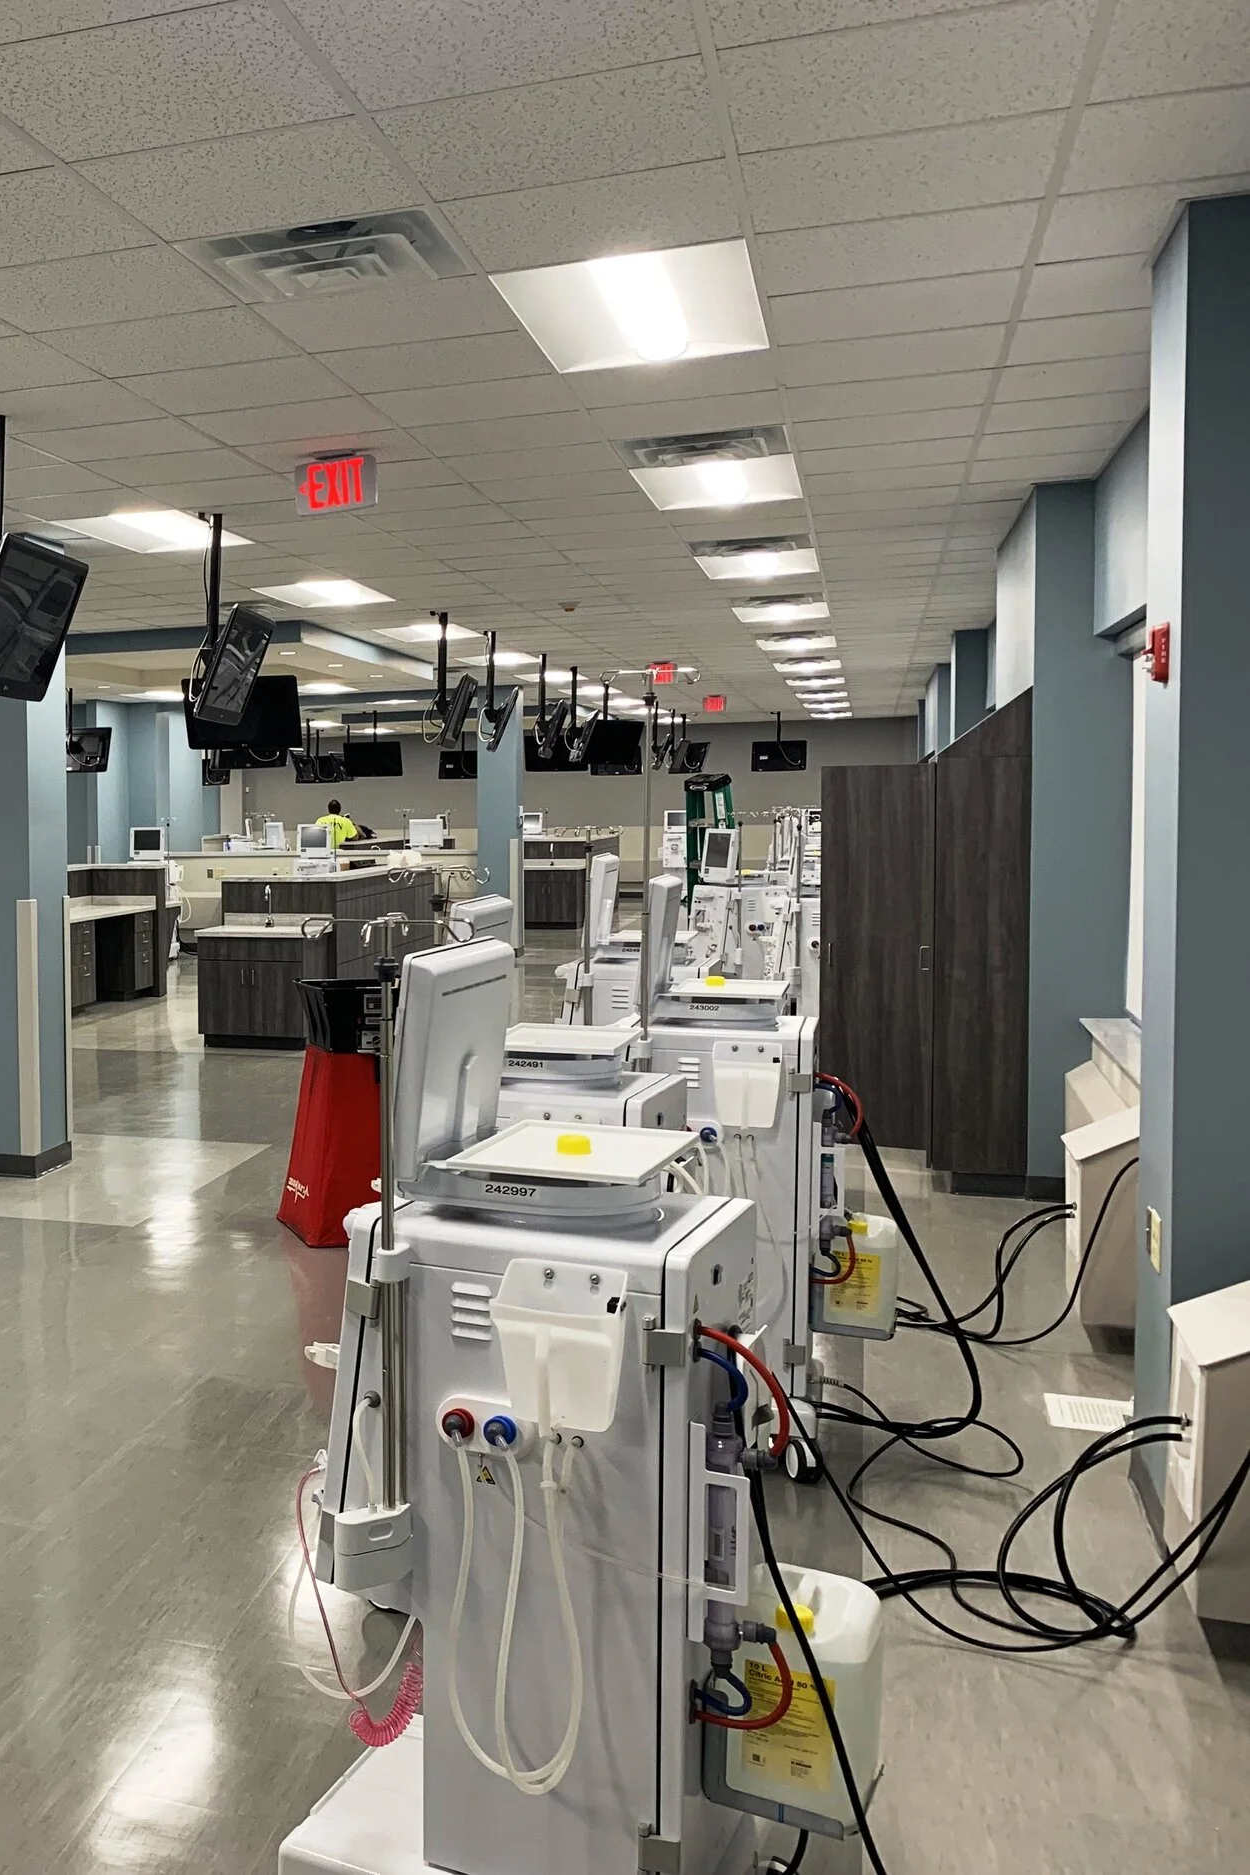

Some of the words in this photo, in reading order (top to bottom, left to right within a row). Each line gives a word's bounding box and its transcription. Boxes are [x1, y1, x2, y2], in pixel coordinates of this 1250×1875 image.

[307, 457, 364, 511] EXIT
[508, 1060, 543, 1068] 242491
[485, 1184, 536, 1197] 242997
[749, 1662, 759, 1670] 10
[749, 1669, 772, 1681] Citric
